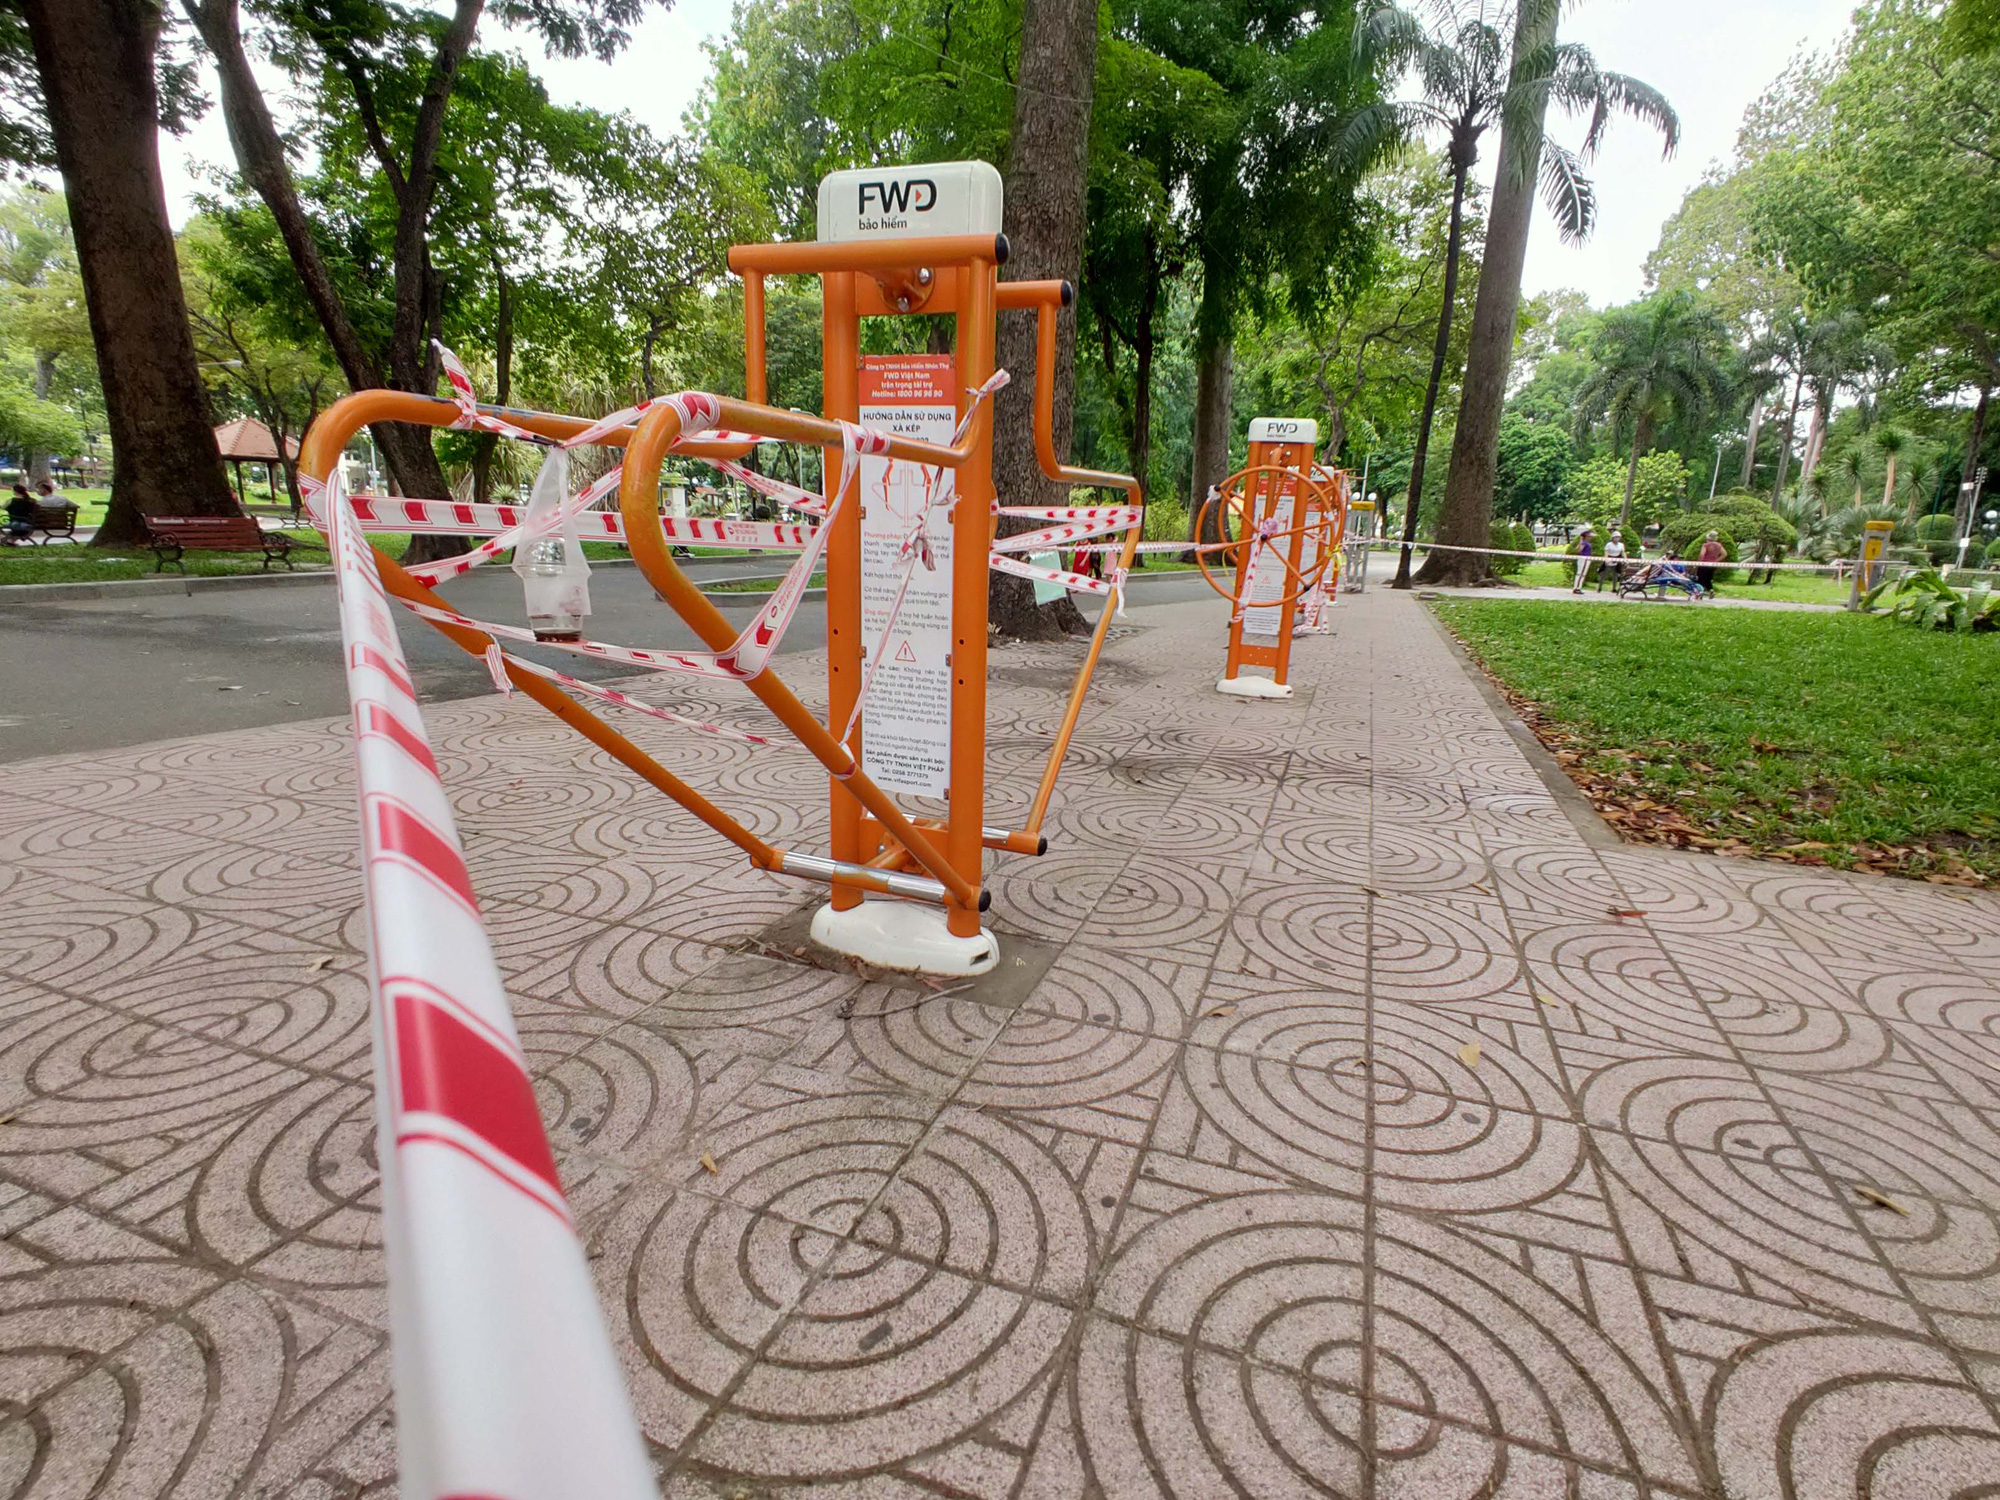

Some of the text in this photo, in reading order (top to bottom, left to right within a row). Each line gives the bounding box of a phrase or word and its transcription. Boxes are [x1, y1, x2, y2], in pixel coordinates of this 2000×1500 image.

[859, 179, 937, 215] FWD
[859, 216, 907, 230] bảo hiểm
[901, 372, 913, 380] Việt
[923, 381, 933, 389] trợ
[863, 411, 893, 420] HƯỚNG
[928, 413, 951, 422] DỤNG
[893, 423, 920, 432] XÀ KÉP
[1267, 422, 1298, 433] FWD
[916, 676, 934, 684] trường
[937, 677, 947, 685] hợp
[867, 756, 884, 764] CÔNG
[895, 760, 911, 768] TNHH
[913, 762, 926, 770] VIỆT
[928, 765, 944, 773] PHÁP
[878, 775, 932, 787] www.vifasport.com
